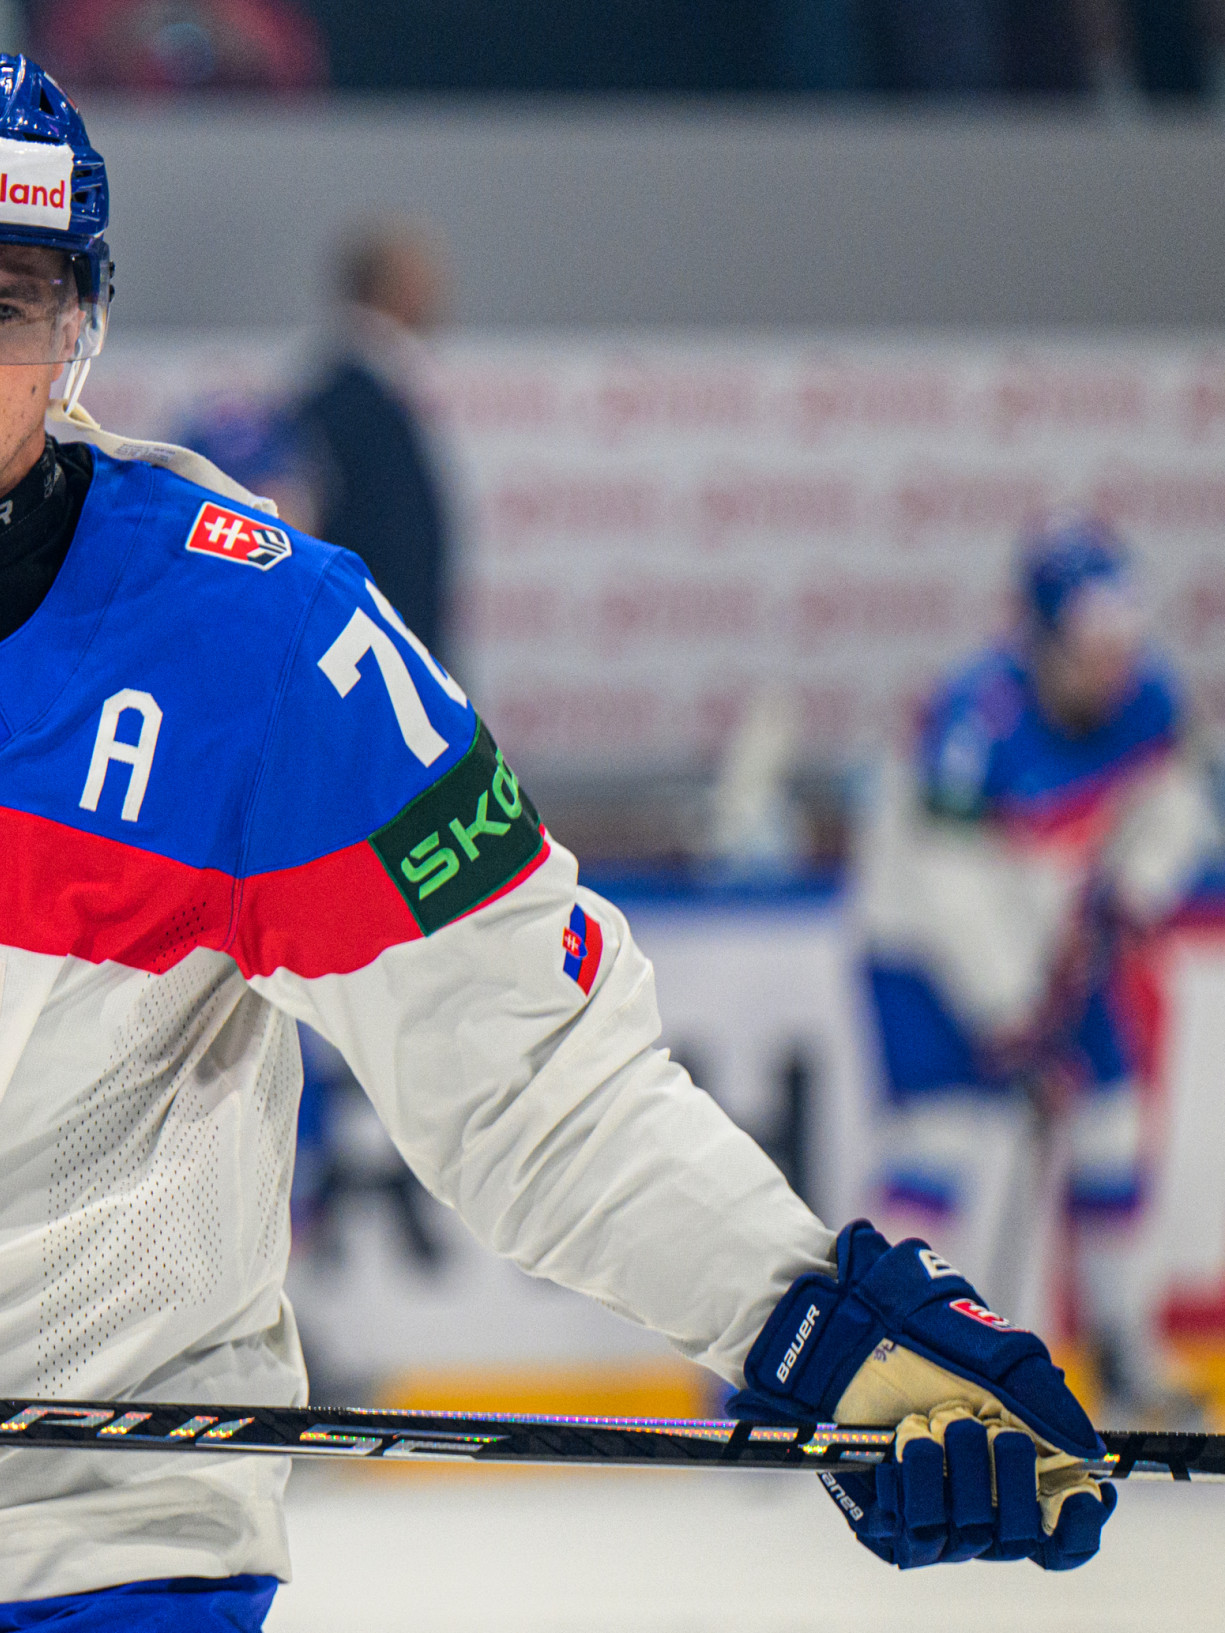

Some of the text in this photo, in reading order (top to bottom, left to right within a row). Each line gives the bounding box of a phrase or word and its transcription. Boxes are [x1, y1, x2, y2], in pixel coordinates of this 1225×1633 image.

[78, 688, 163, 822] A
[776, 1304, 820, 1384] BAUER
[821, 1471, 864, 1522] BAUE
